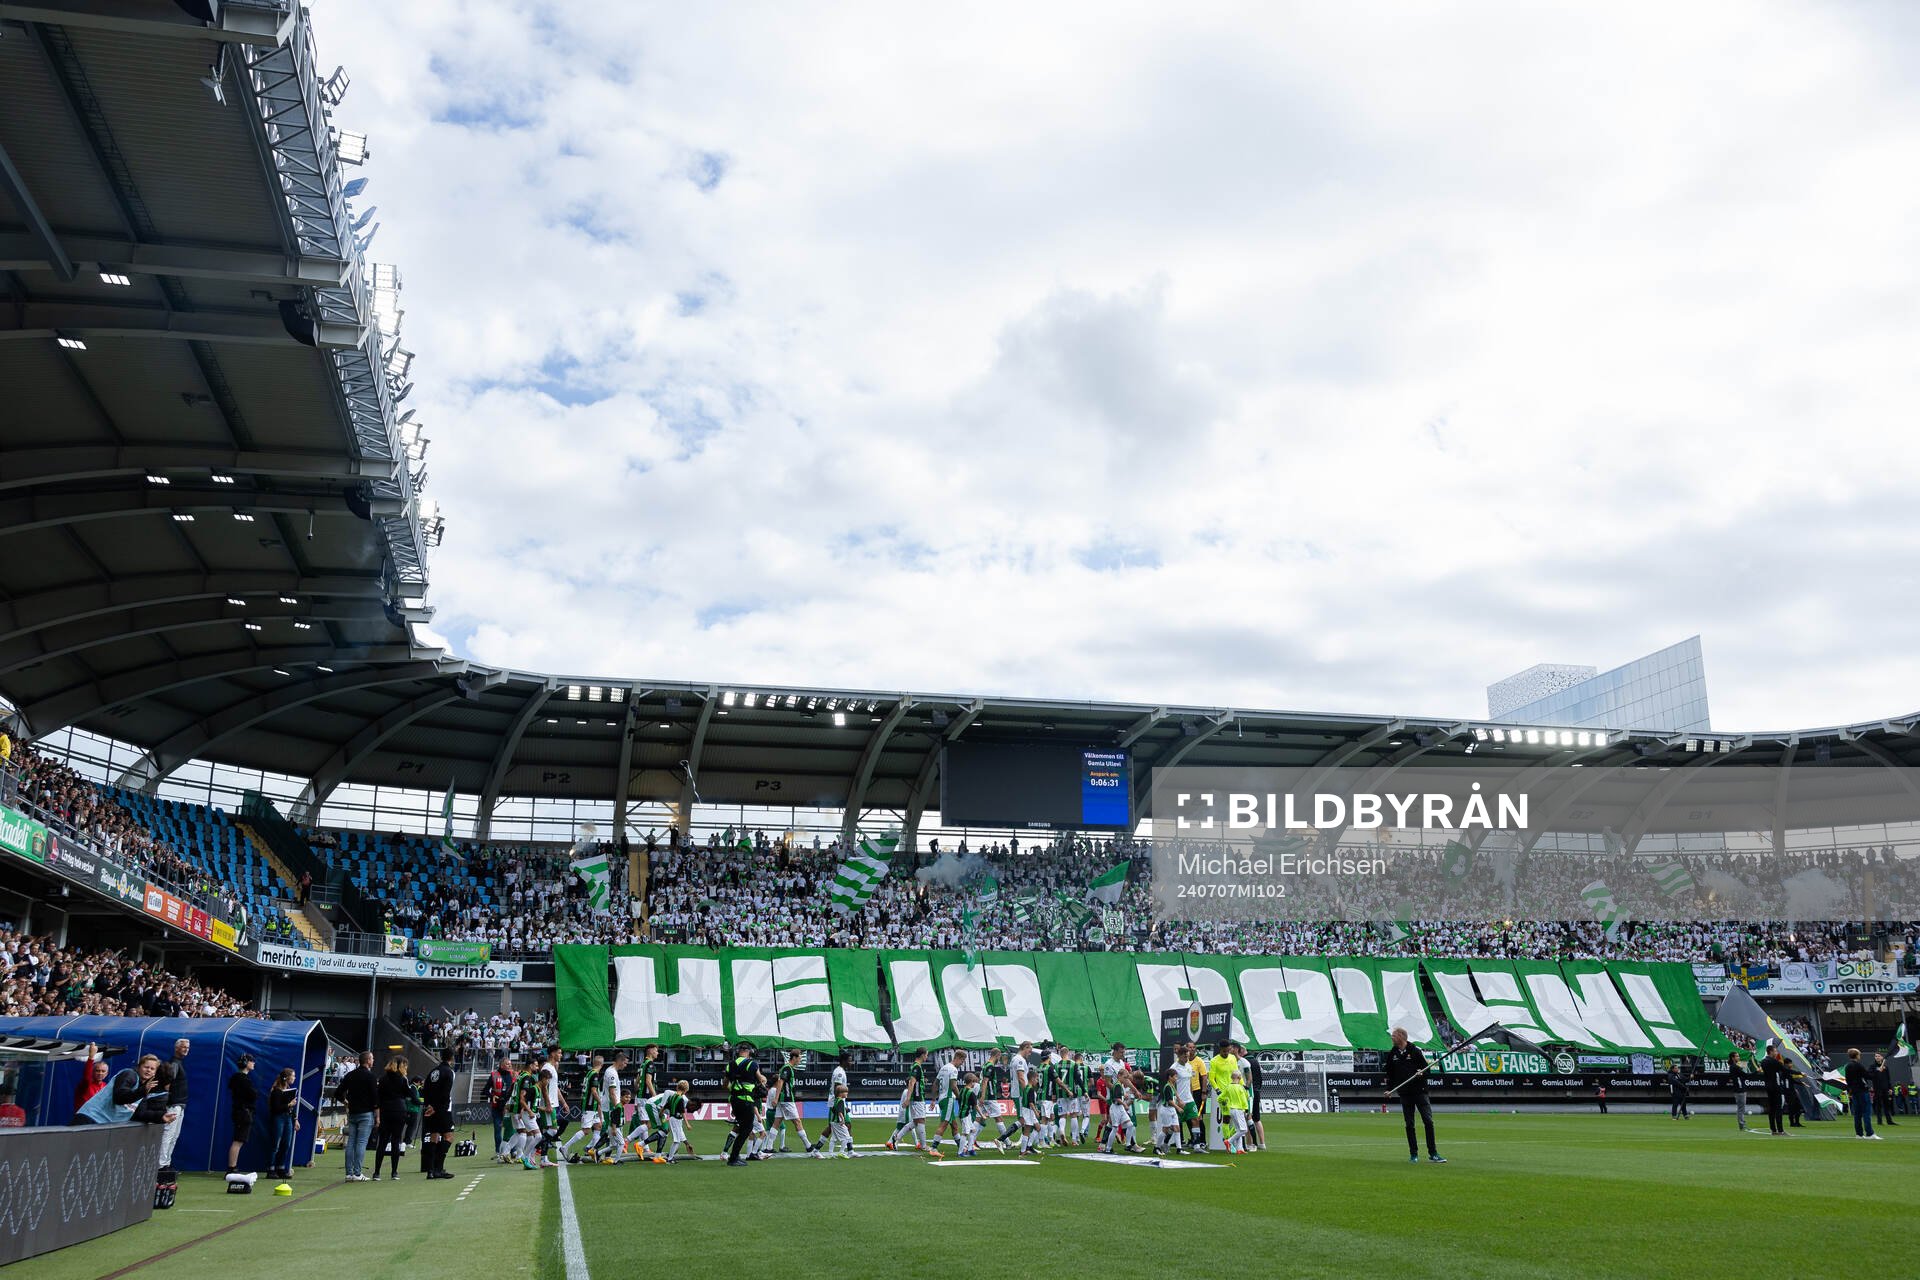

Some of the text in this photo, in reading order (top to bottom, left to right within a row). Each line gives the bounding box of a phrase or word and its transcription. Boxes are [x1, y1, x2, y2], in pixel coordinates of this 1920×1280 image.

[1084, 752, 1115, 760] Välkommen
[397, 761, 425, 773] P1
[542, 771, 571, 783] P2
[755, 780, 782, 791] P3
[1090, 779, 1119, 787] 0:06:31
[0, 810, 29, 851] icadeli
[261, 949, 315, 969] merinfo.se
[318, 956, 332, 966] Vad
[333, 958, 345, 967] vill
[346, 959, 357, 968] du
[430, 963, 518, 979] merinfo.se
[1829, 981, 1916, 993] merinfo.se
[613, 956, 1054, 1044] HEJA
[1164, 1017, 1184, 1030] UNIBET
[1206, 1012, 1228, 1026] UNIBET
[1442, 1052, 1539, 1073] BAJEN FANS
[1060, 1069, 1068, 1083] 7
[692, 1078, 719, 1086] Gamla
[805, 1078, 828, 1086] Ullevi
[861, 1078, 907, 1086] Gamla Ullev
[1261, 1078, 1277, 1086] amla
[1279, 1078, 1299, 1086] Ullevi
[1327, 1078, 1351, 1086] Gamla
[1351, 1078, 1371, 1086] Ullevi
[1472, 1078, 1514, 1086] Gamla Ullevi
[1541, 1078, 1583, 1086] Gamla Ullevi
[1611, 1078, 1651, 1086] Gamla Ullevi
[1699, 1078, 1718, 1086] Ullevi
[1744, 1078, 1766, 1086] Gamla
[1260, 1098, 1323, 1114] BESKO
